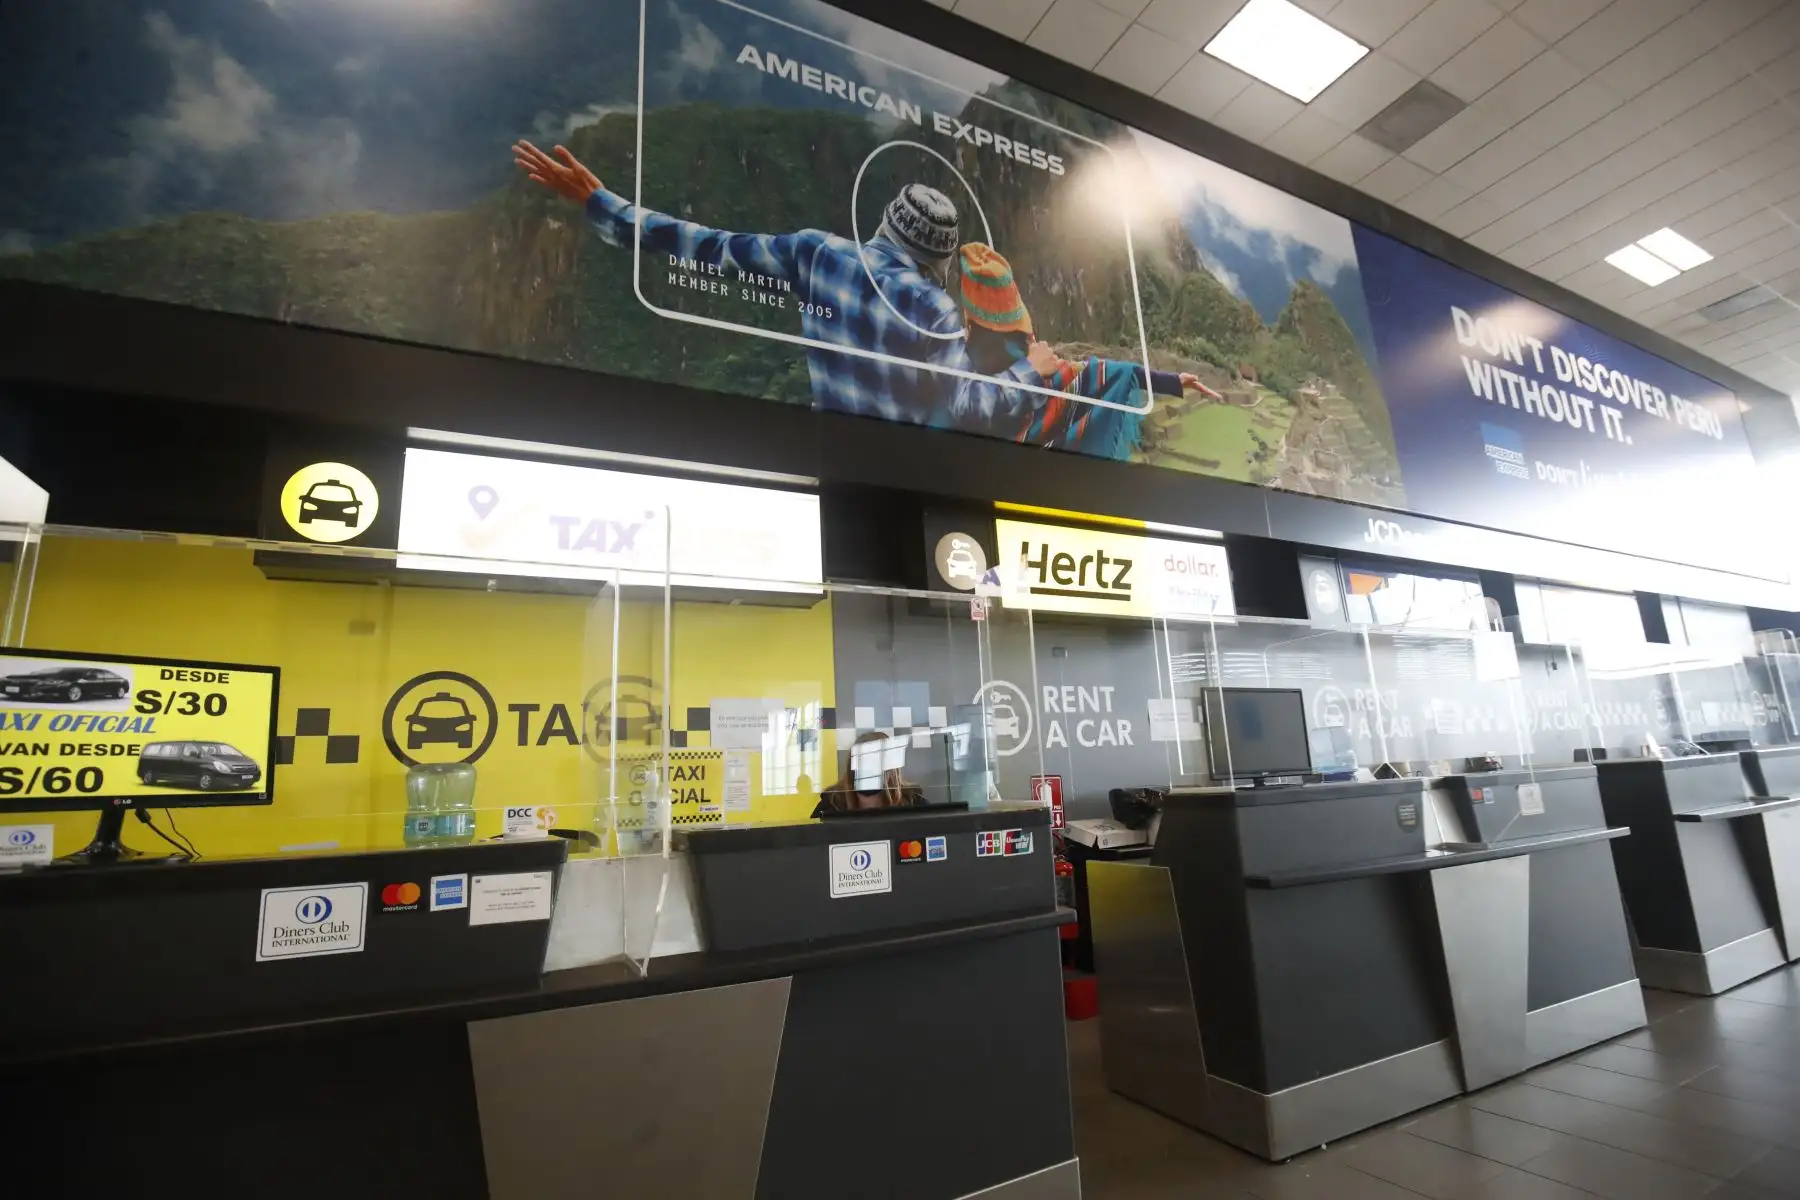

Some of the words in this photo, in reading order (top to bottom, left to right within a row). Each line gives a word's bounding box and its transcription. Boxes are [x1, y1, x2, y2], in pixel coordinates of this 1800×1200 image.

[736, 44, 922, 125] AMERICAN
[933, 114, 1065, 176] EXPRESS
[669, 254, 725, 278] DANIEL
[738, 269, 791, 293] MARTIN
[669, 273, 728, 296] MEMBER
[741, 288, 786, 310] SINCE
[798, 301, 833, 319] 2005
[1451, 306, 1543, 373] DON'T
[1551, 346, 1671, 420] DISCOVER
[1671, 394, 1724, 440] PERU
[1461, 356, 1595, 434] WITHOUT
[1601, 402, 1632, 444] IT.
[1021, 541, 1132, 590] Hertz
[160, 669, 230, 684] DESDE
[134, 689, 228, 717] S/30
[1043, 685, 1115, 714] RENT
[49, 713, 157, 734] OFICIAL
[1046, 721, 1067, 749] A
[1076, 719, 1135, 748] CAR
[0, 743, 49, 757] VAN
[60, 744, 140, 757] DESDE
[0, 766, 104, 795] S/60
[508, 808, 532, 818] DCC
[978, 840, 1000, 849] JCB
[838, 872, 863, 881] Diners
[864, 869, 883, 879] Club
[838, 879, 884, 888] INTERNATIONAL
[272, 926, 316, 939] Diners
[319, 921, 350, 935] Club
[272, 933, 350, 948] INTERNATIONAL
